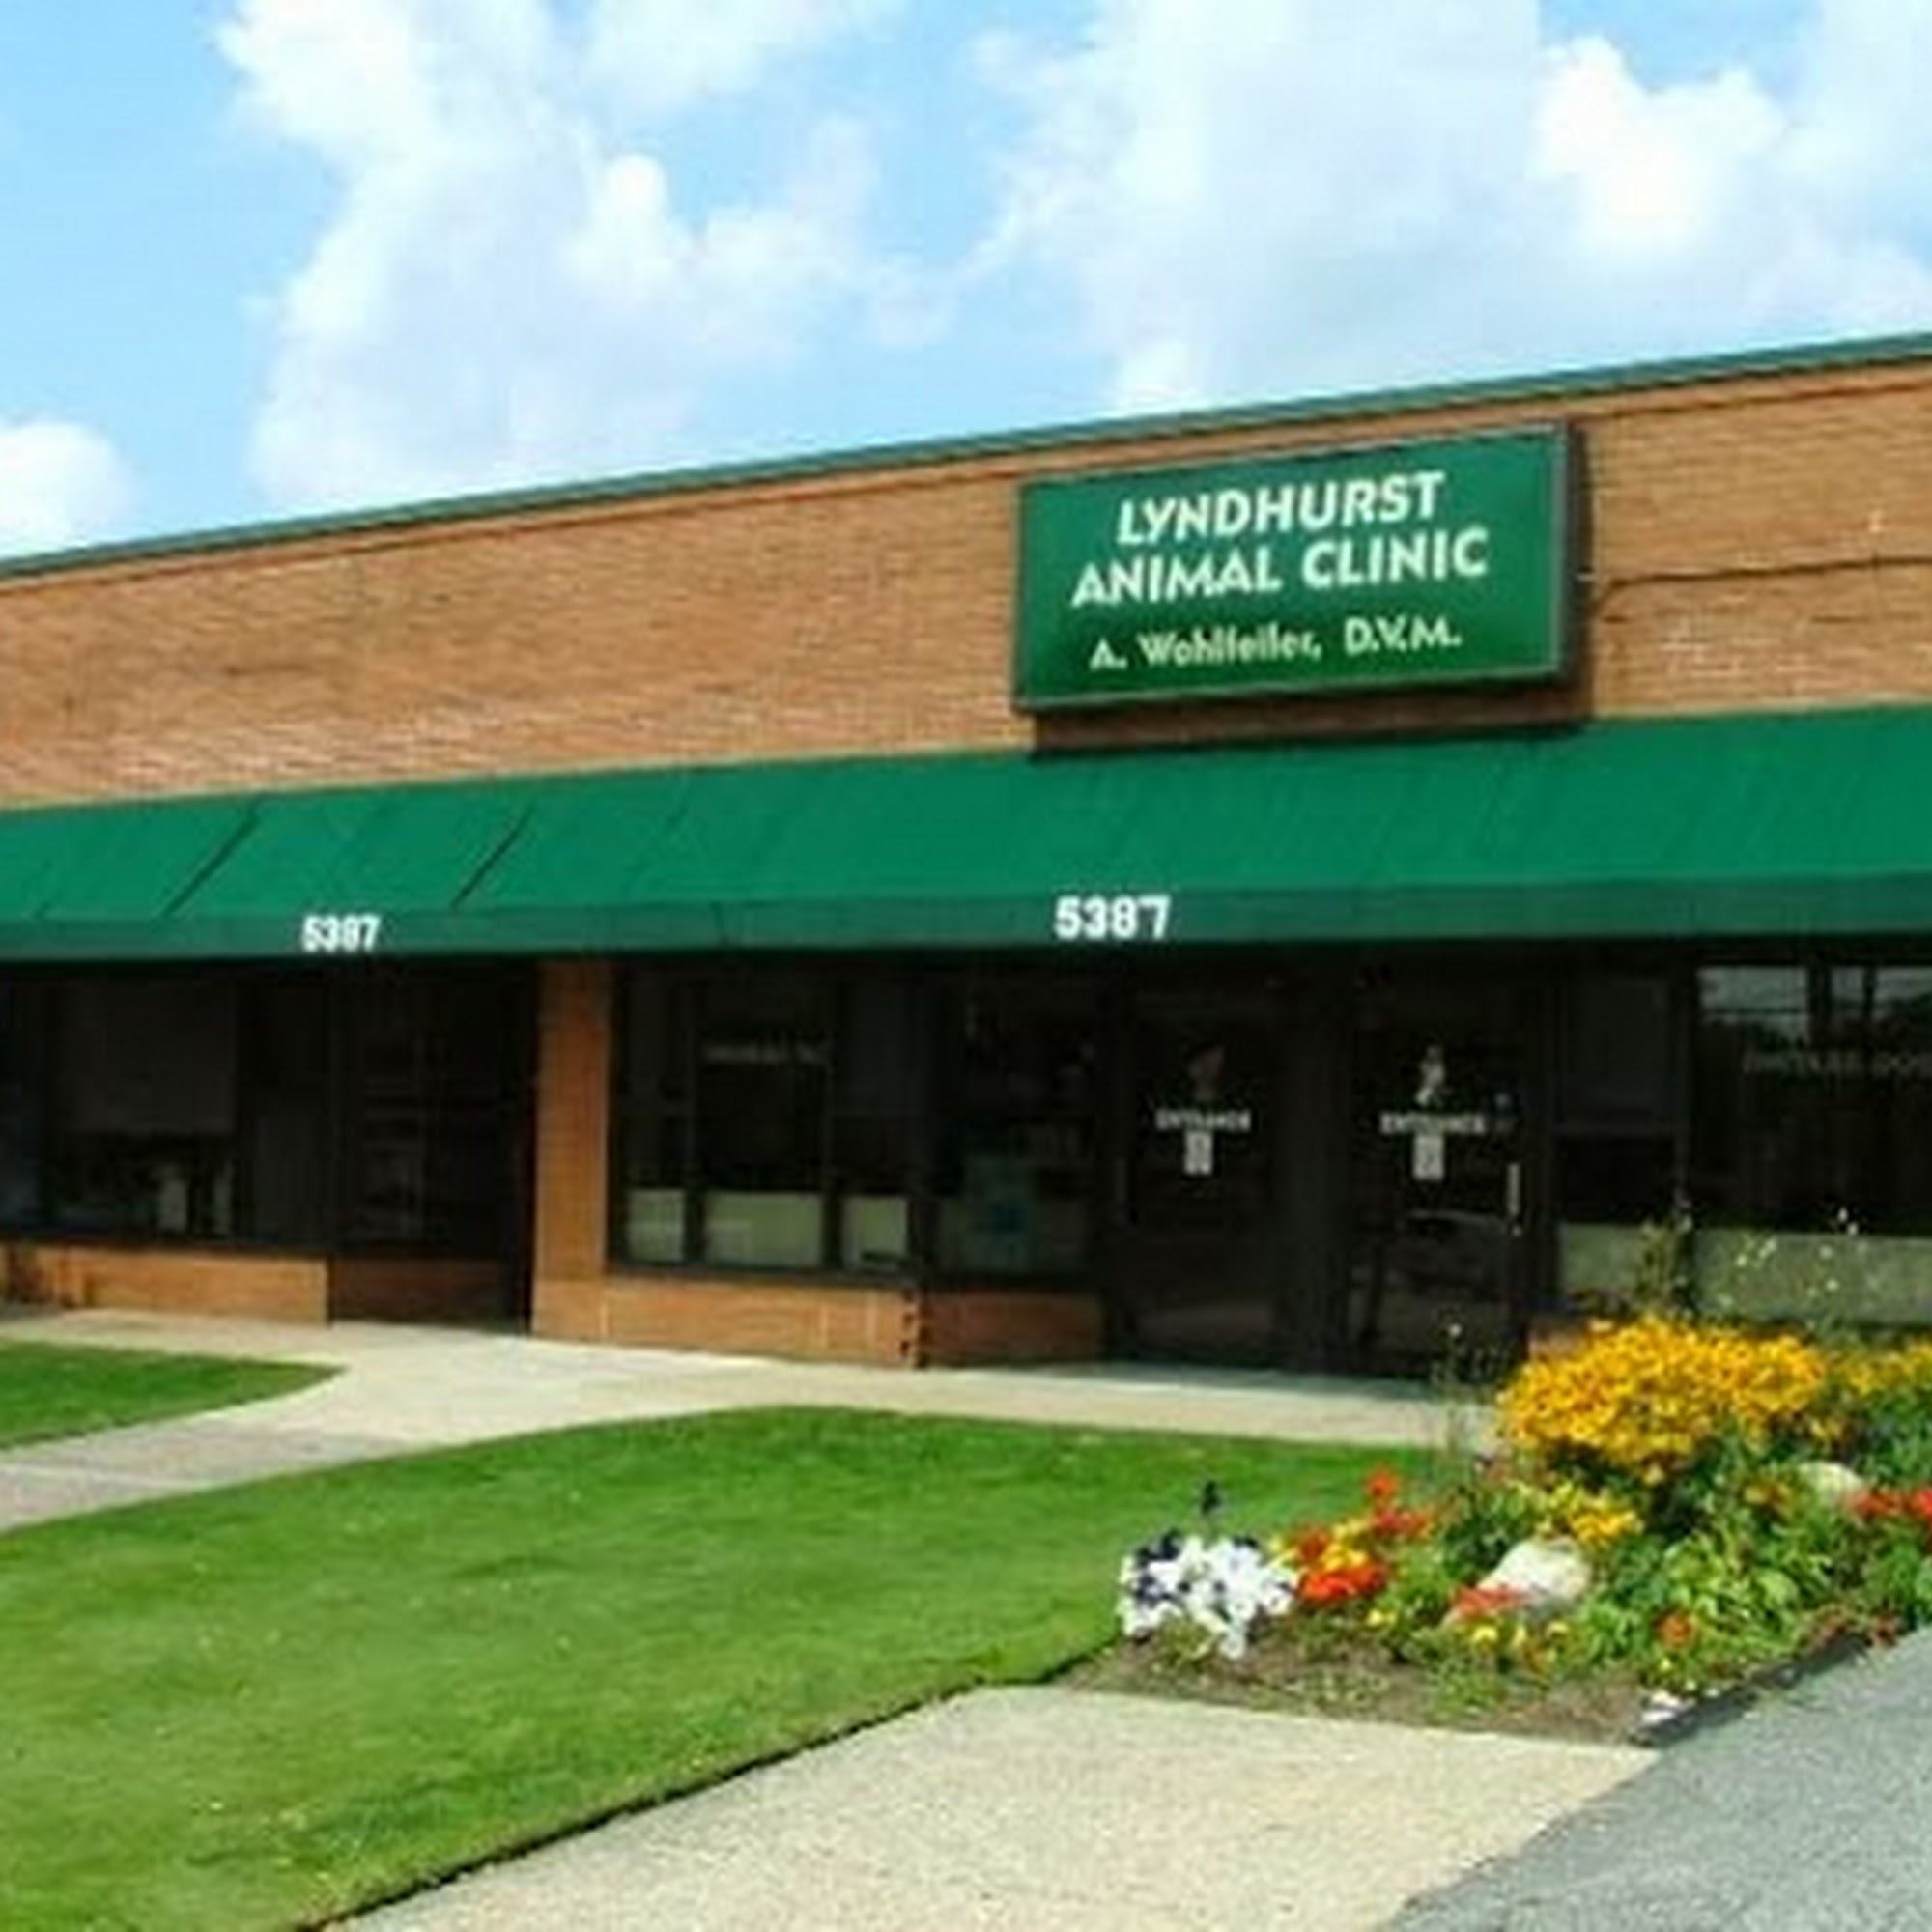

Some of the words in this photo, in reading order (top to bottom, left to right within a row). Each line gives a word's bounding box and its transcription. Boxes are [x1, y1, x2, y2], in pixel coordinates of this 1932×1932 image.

[1117, 471, 1445, 546] LYNDHURST
[1071, 547, 1283, 608] ANIMAL
[1300, 527, 1489, 589] CLINIC
[1089, 638, 1128, 670] A.
[1343, 613, 1463, 657] D.V.M.
[1054, 894, 1171, 940] 5387
